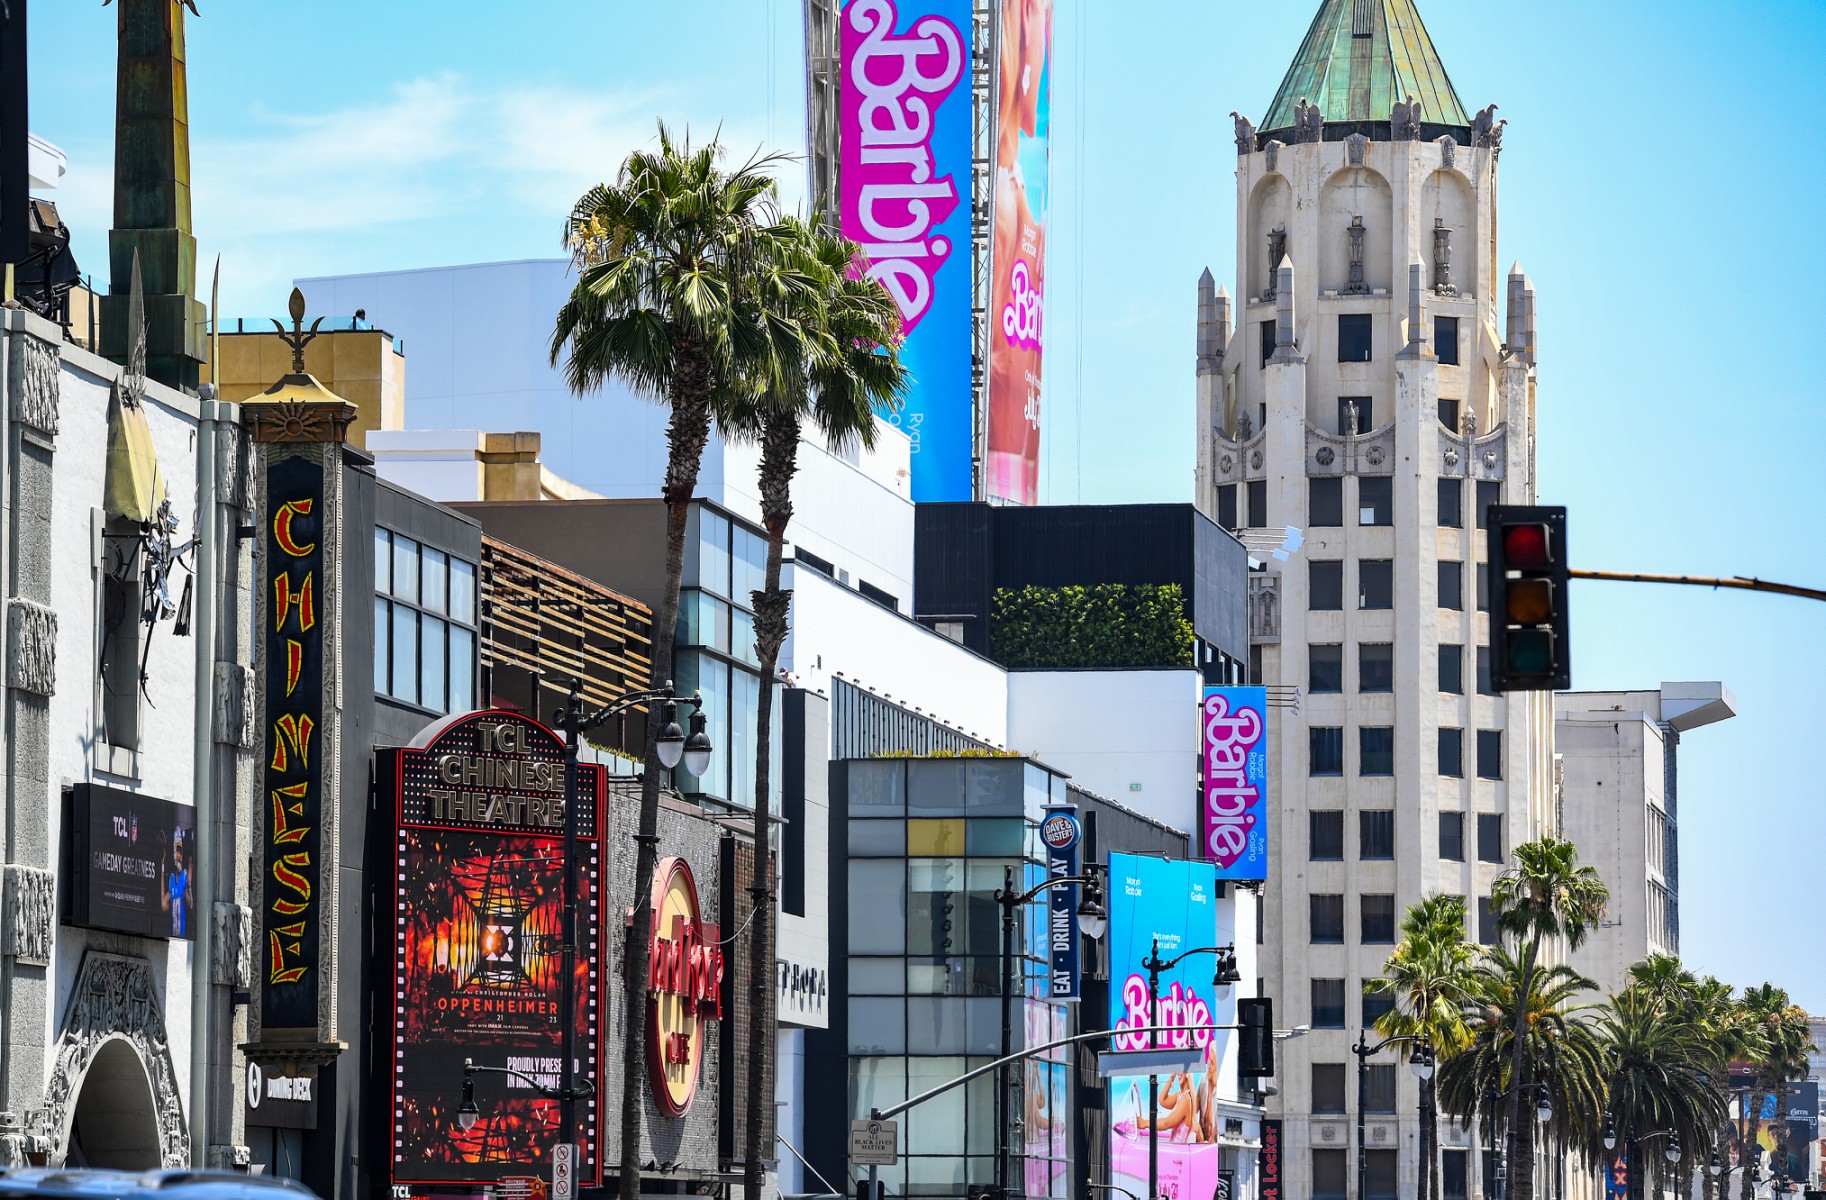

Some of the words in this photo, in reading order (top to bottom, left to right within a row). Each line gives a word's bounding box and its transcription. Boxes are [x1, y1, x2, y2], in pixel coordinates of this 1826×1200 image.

[850, 0, 961, 323] Barbie
[907, 413, 924, 454] Ryan
[270, 498, 315, 986] CHINESE
[477, 721, 532, 754] TCL
[439, 754, 565, 792] CHINESE
[1206, 695, 1261, 857] Barbie
[1249, 752, 1257, 781] Robbie
[429, 790, 566, 828] THEATRE
[113, 816, 128, 838] TCL
[1045, 820, 1065, 834] DAVE
[1064, 820, 1072, 829] &
[1248, 831, 1257, 862] Gosling
[94, 852, 122, 873] GAMEDAY
[123, 857, 156, 879] GREATNESS
[1053, 908, 1071, 951] DRINK
[1053, 969, 1071, 994] EAT
[437, 997, 557, 1014] OPPENHEIMER
[507, 1056, 539, 1072] PROUDLY
[540, 1057, 579, 1074] PRESED
[1263, 1125, 1277, 1182] Locker
[392, 1185, 411, 1199] TCL
